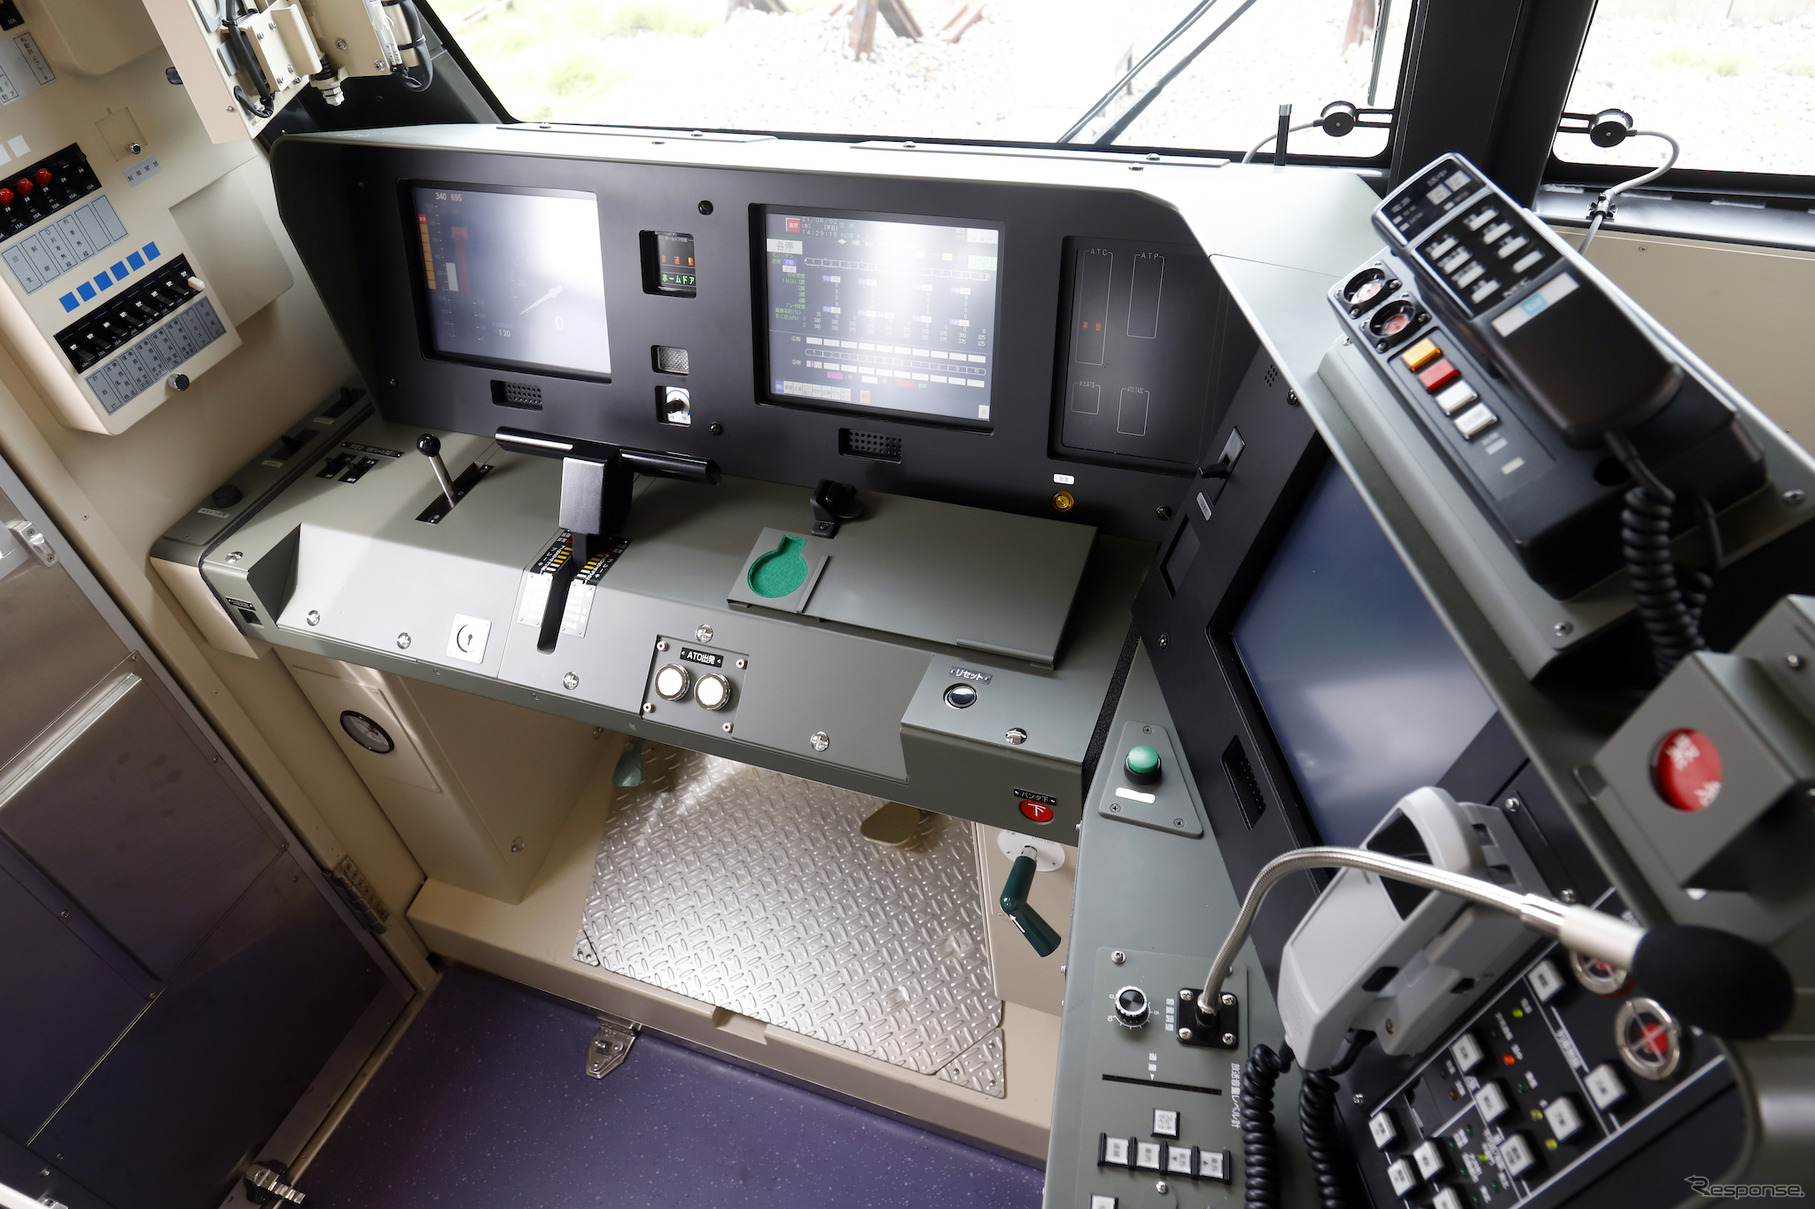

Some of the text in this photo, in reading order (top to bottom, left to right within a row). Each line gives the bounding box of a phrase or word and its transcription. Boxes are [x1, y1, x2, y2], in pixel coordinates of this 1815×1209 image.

[451, 193, 462, 202] 695
[662, 274, 695, 284] ホームドア
[555, 316, 564, 330] 0
[687, 651, 716, 665] ATO出発
[956, 669, 984, 681] リセット
[1021, 792, 1049, 803] パンタ下
[1028, 802, 1046, 817] 下
[1165, 998, 1175, 1032] 音量調整
[1231, 1062, 1241, 1129] 放送音量レベル計
